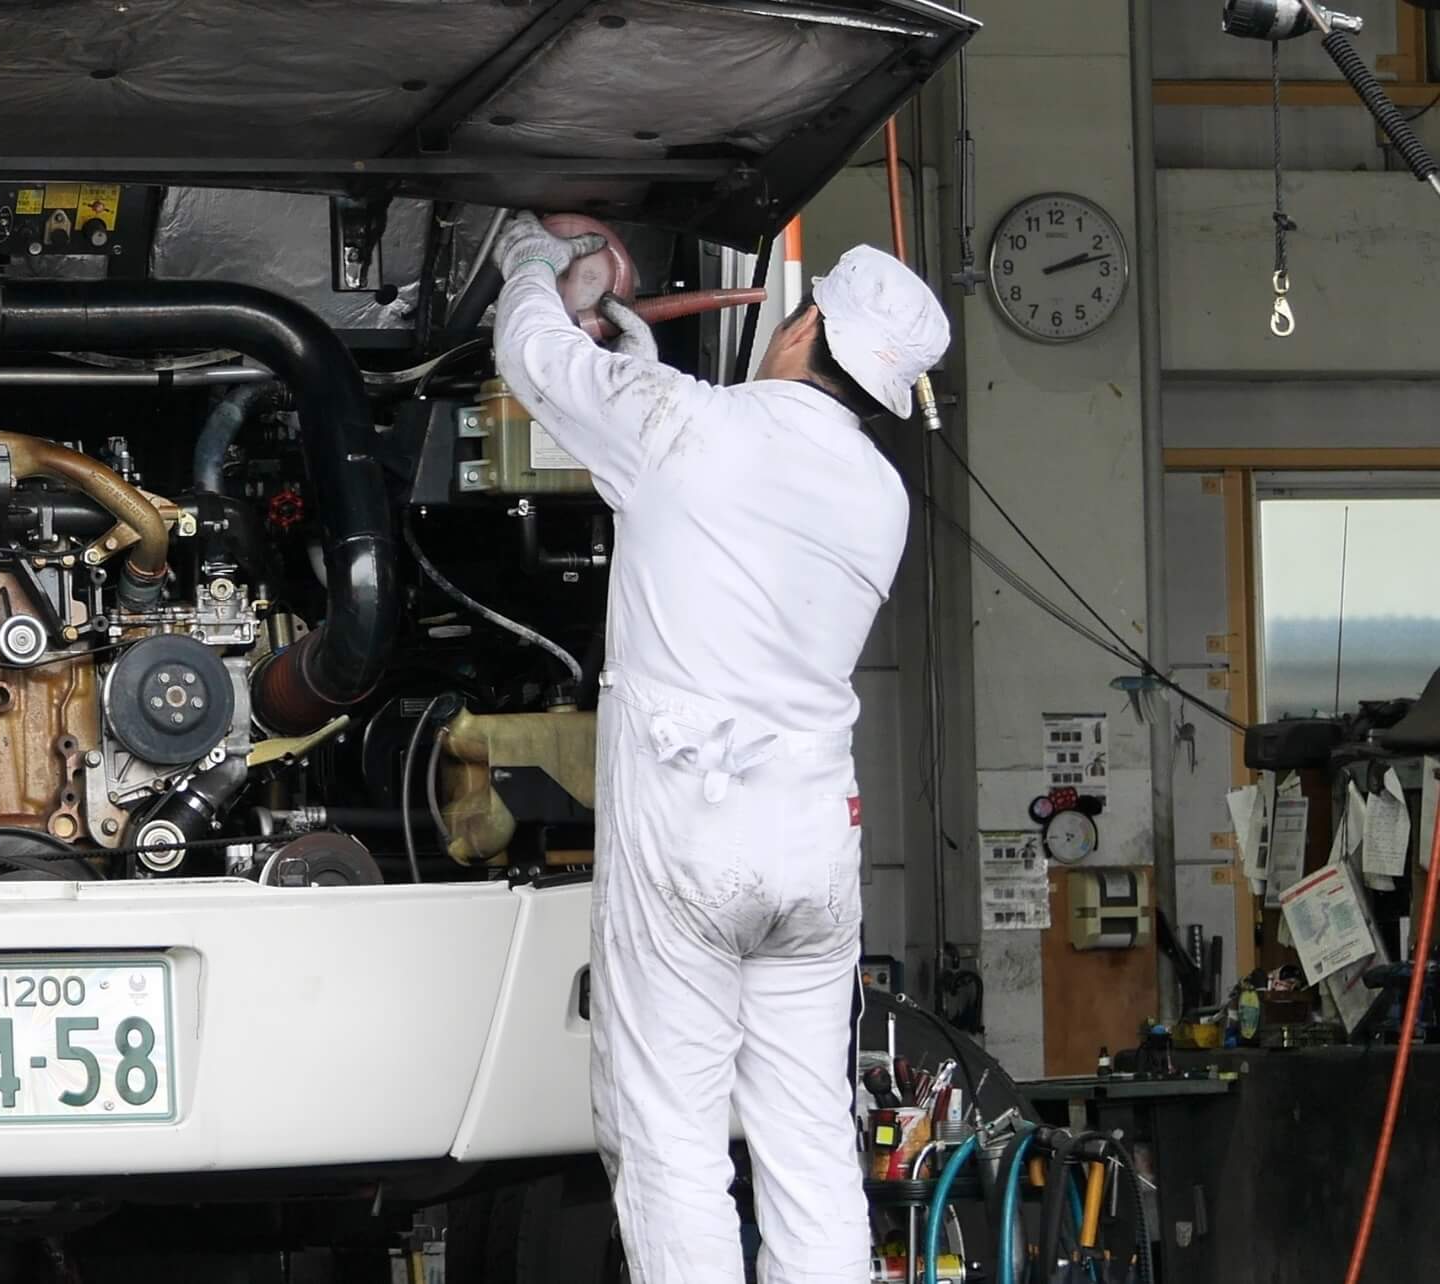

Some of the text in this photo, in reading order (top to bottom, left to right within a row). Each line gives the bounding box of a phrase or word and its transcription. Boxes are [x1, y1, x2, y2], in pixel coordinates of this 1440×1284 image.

[1026, 217, 1040, 232] 11
[1047, 210, 1064, 225] 12
[1076, 217, 1083, 232] 1
[1010, 235, 1027, 250] 10
[1092, 235, 1103, 250] 2
[1002, 260, 1014, 275] 9
[1099, 261, 1110, 277] 3
[1010, 286, 1021, 301] 8
[1091, 287, 1103, 301] 4
[1028, 304, 1039, 319] 7
[1075, 305, 1086, 320] 5
[1051, 312, 1062, 327] 6
